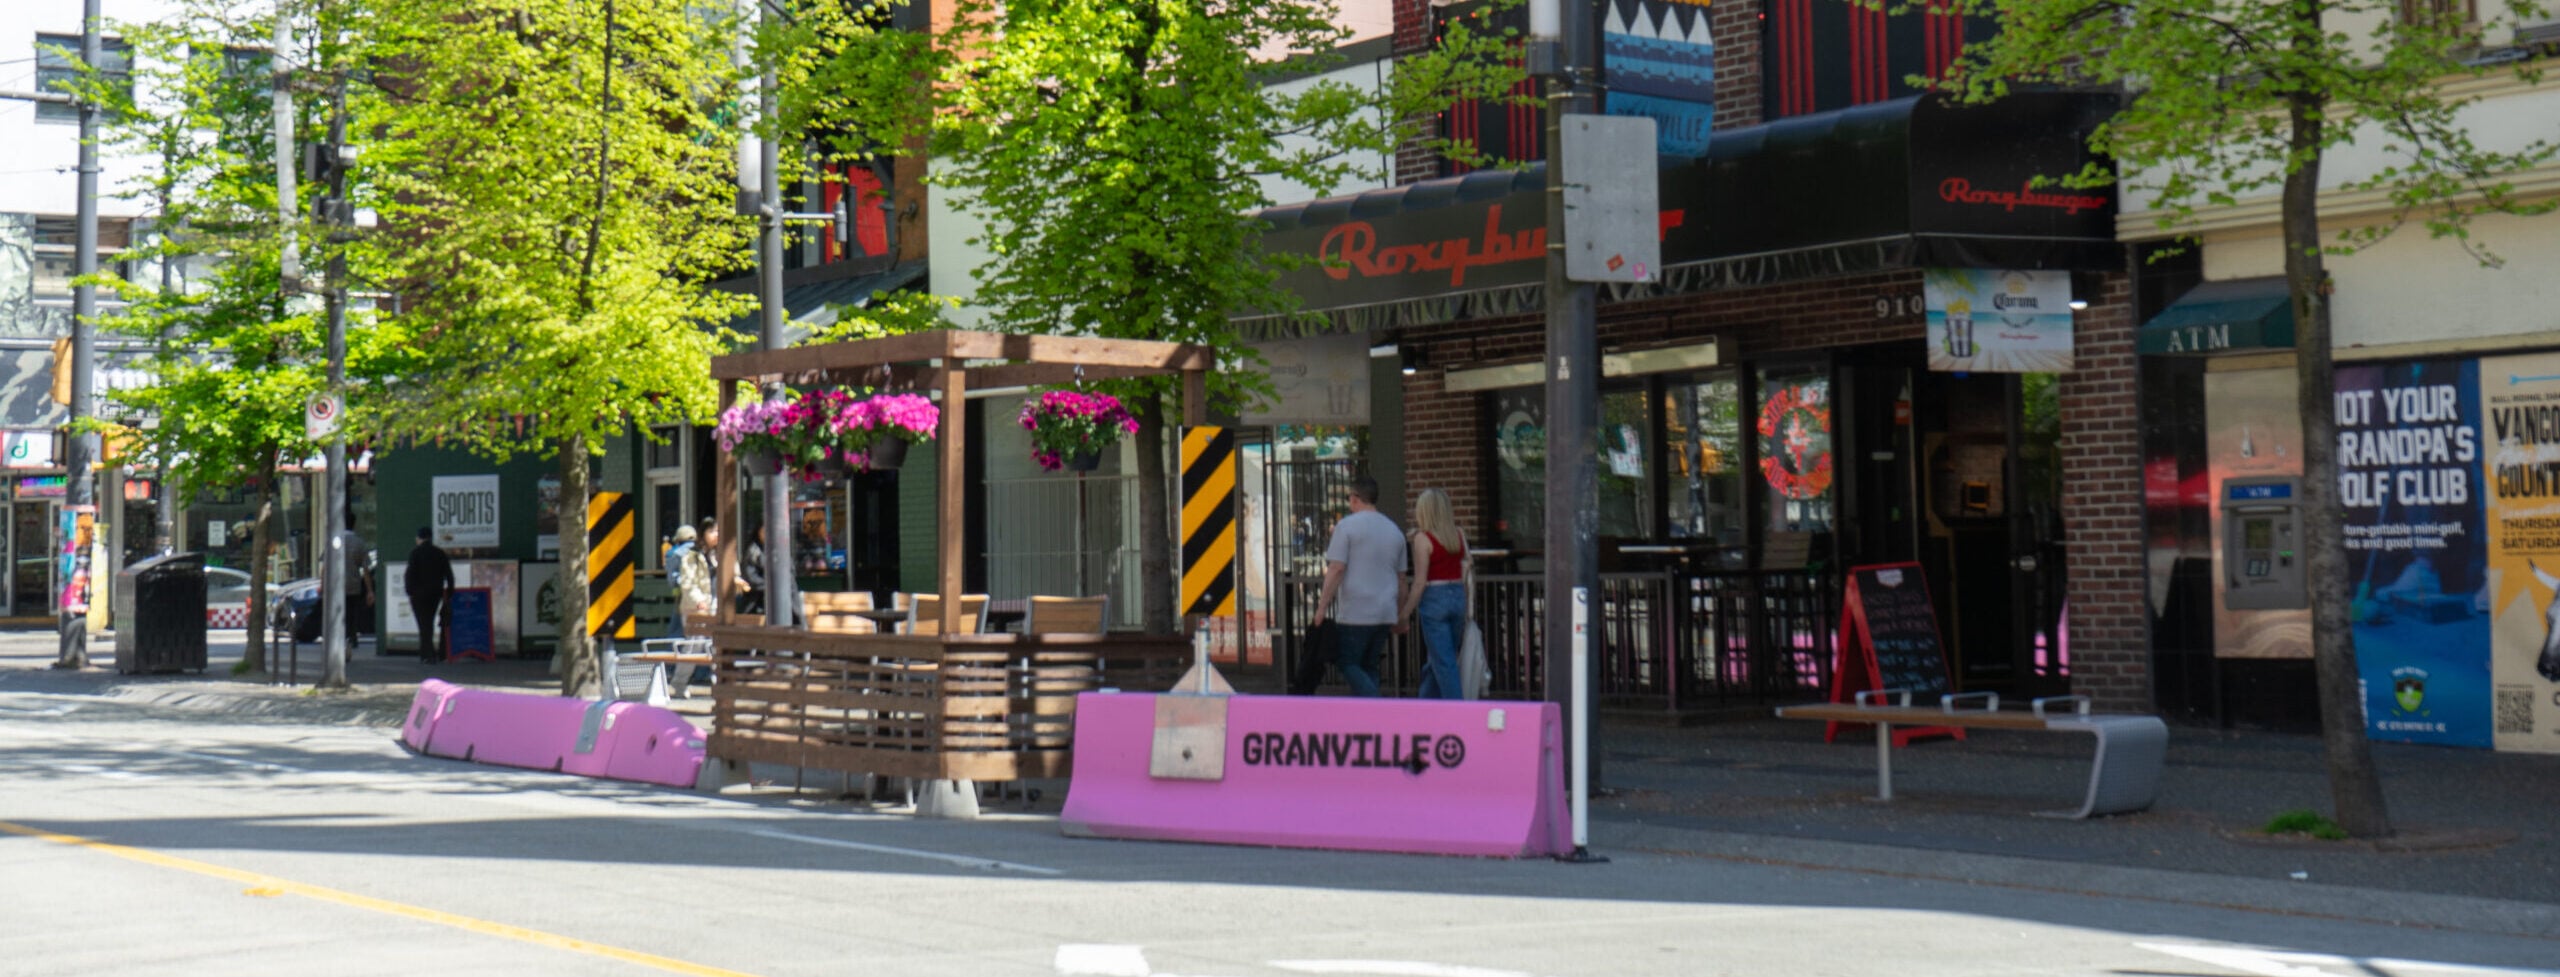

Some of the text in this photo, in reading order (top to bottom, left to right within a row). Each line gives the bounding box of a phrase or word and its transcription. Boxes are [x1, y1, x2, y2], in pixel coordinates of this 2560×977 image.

[1938, 176, 2108, 215] Roxyburger
[1875, 295, 1923, 318] 910
[2167, 324, 2230, 352] ATM
[2381, 384, 2458, 423] YOUR
[2337, 425, 2476, 466] RANDPA'S
[2339, 467, 2468, 507] OLF CLUB
[437, 491, 495, 526] SPORTS
[1243, 733, 1432, 768] GRANVILLE
